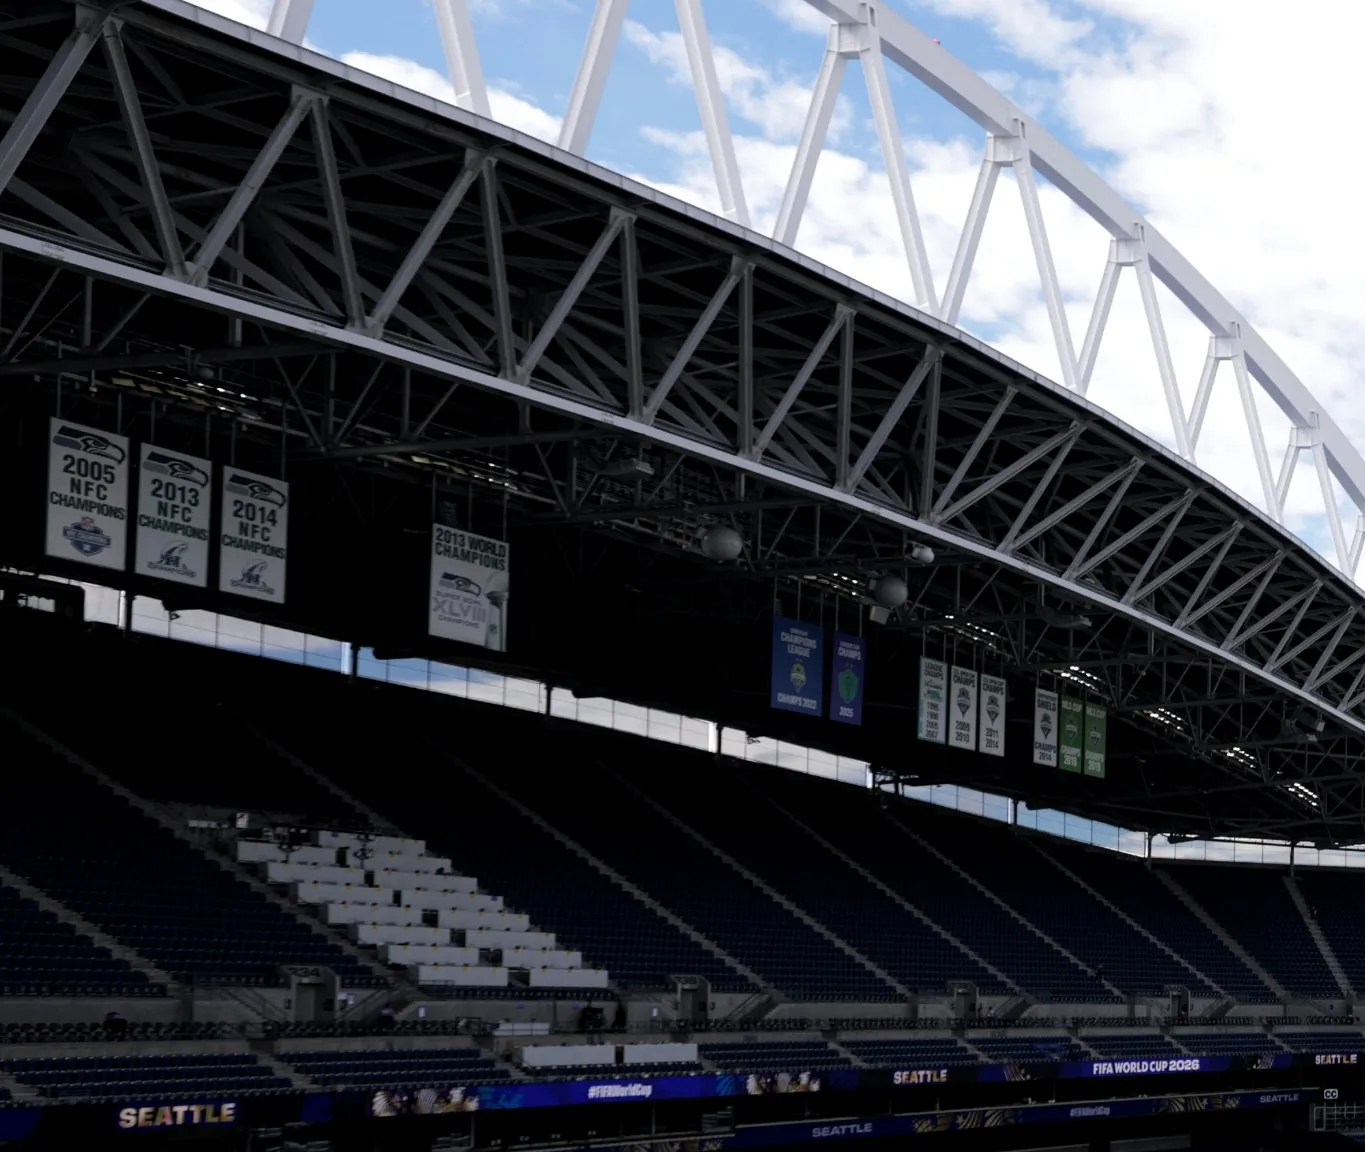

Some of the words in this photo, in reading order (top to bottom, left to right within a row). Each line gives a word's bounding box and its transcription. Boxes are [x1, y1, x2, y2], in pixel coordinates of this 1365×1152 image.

[63, 454, 115, 485] 2005
[70, 477, 108, 501] NFC
[151, 478, 201, 507] 2013
[50, 491, 125, 520] CHAMPIONS
[157, 501, 192, 523] NFC
[233, 500, 277, 527] 2014
[138, 514, 209, 541] CHAMPIONS
[238, 521, 271, 542] NFC
[221, 534, 286, 559] CHAMPIONS
[436, 528, 466, 548] 2013
[467, 536, 506, 558] WORLD
[435, 542, 506, 571] CHAMPIONS
[432, 598, 487, 623] XLVIII
[781, 631, 817, 650] CHAMPIONS
[953, 674, 977, 689] CHAMPS
[955, 731, 970, 744] 2010
[985, 728, 999, 739] 2011
[985, 738, 999, 750] 2014
[1092, 1061, 1113, 1075] FIFA
[1114, 1060, 1149, 1073] WORLD
[1150, 1059, 1169, 1072] CUP
[1169, 1058, 1200, 1071] 2026
[1315, 1053, 1358, 1066] SEATTLE
[893, 1068, 948, 1085] SEATTLE
[1259, 1093, 1300, 1105] SEATTLE
[1325, 1089, 1338, 1099] CC
[118, 1102, 237, 1129] SEATTLE
[811, 1122, 873, 1139] SEATTLE
